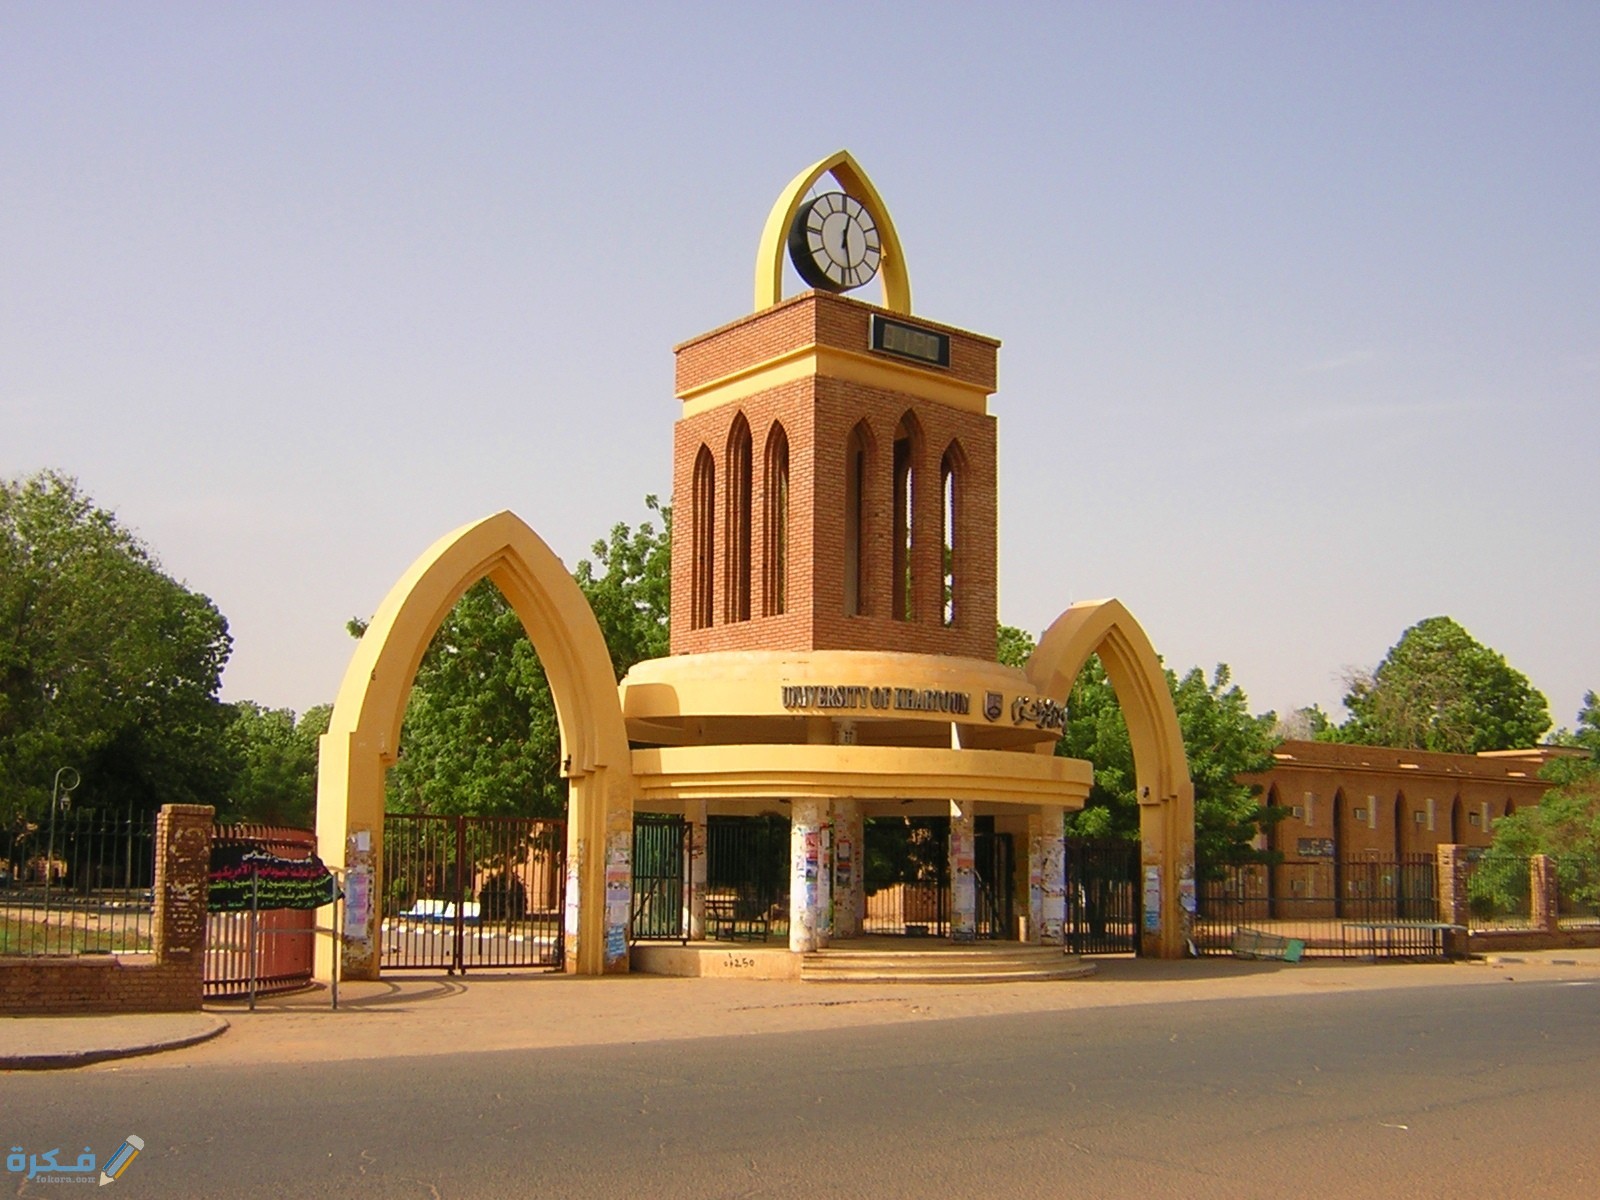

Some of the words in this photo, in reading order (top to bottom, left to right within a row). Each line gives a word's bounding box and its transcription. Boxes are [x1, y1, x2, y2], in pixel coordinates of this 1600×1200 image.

[781, 685, 869, 709] UNIVERSITY
[871, 687, 891, 709] OF
[893, 687, 970, 715] KHARTOUM
